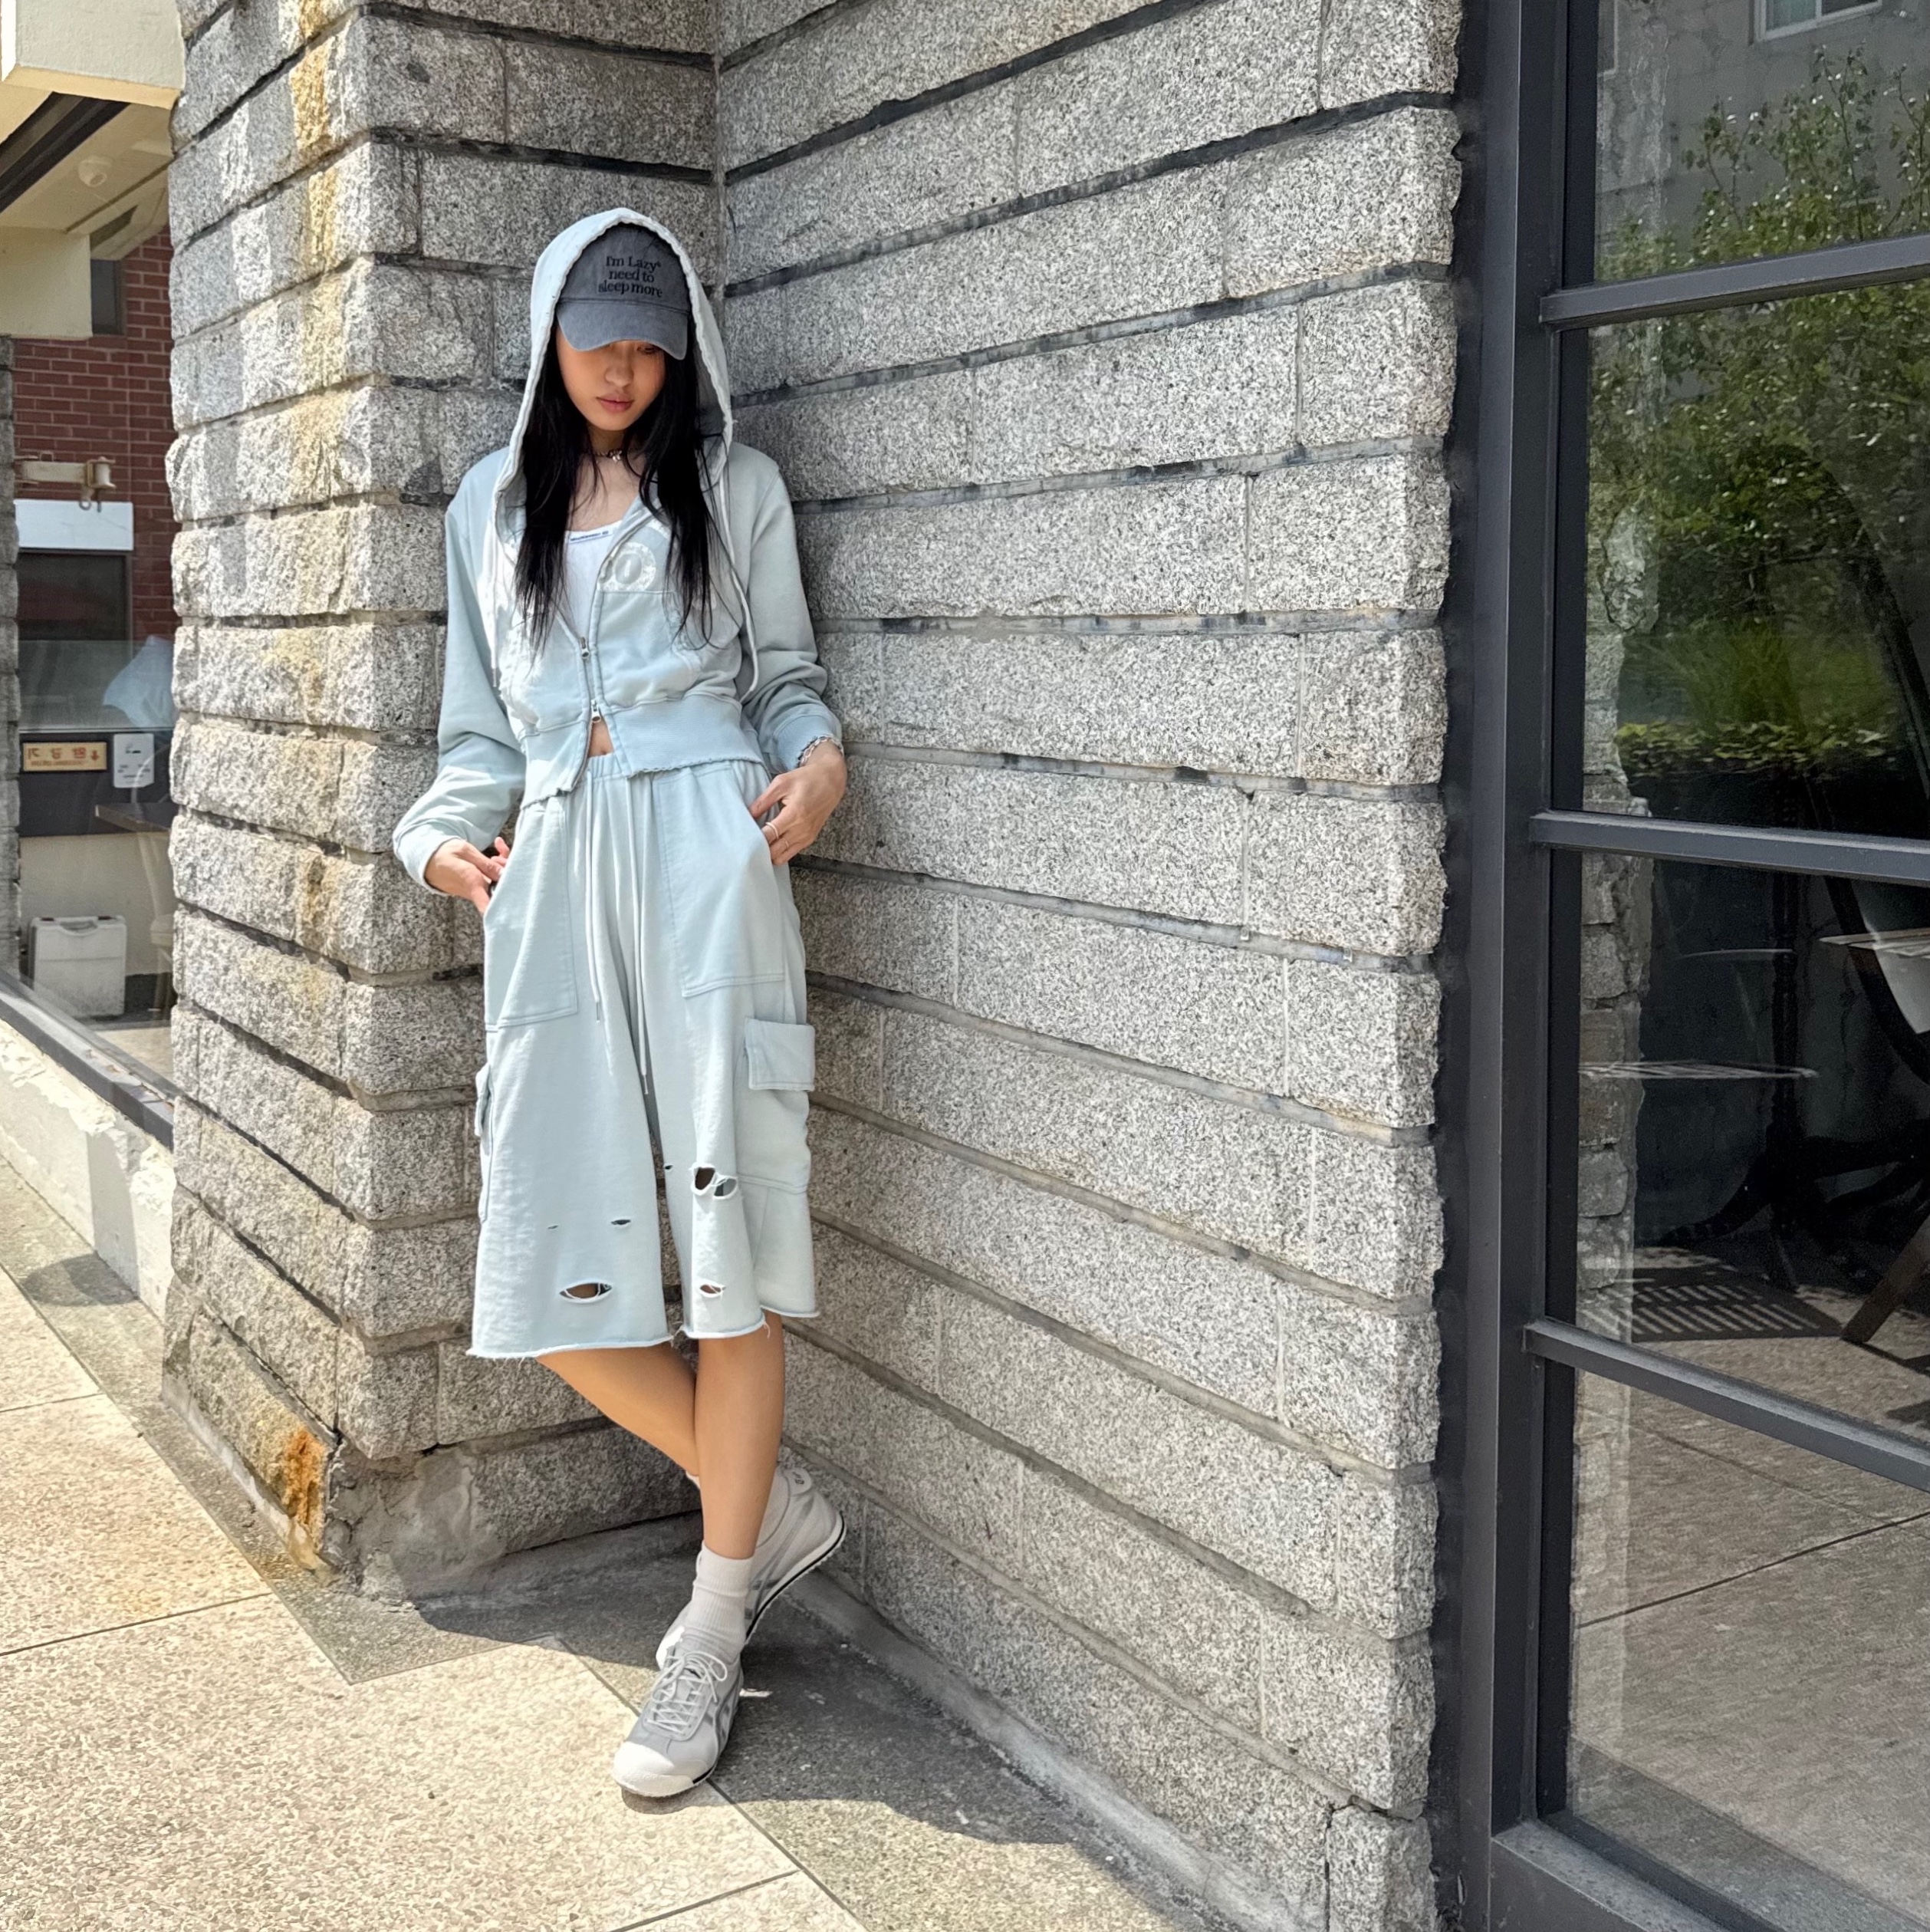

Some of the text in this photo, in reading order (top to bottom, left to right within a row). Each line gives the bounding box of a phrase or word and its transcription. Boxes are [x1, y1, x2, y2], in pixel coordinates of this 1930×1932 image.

[606, 255, 624, 267] I'm
[609, 268, 655, 283] need to
[598, 279, 663, 298] sleep more
